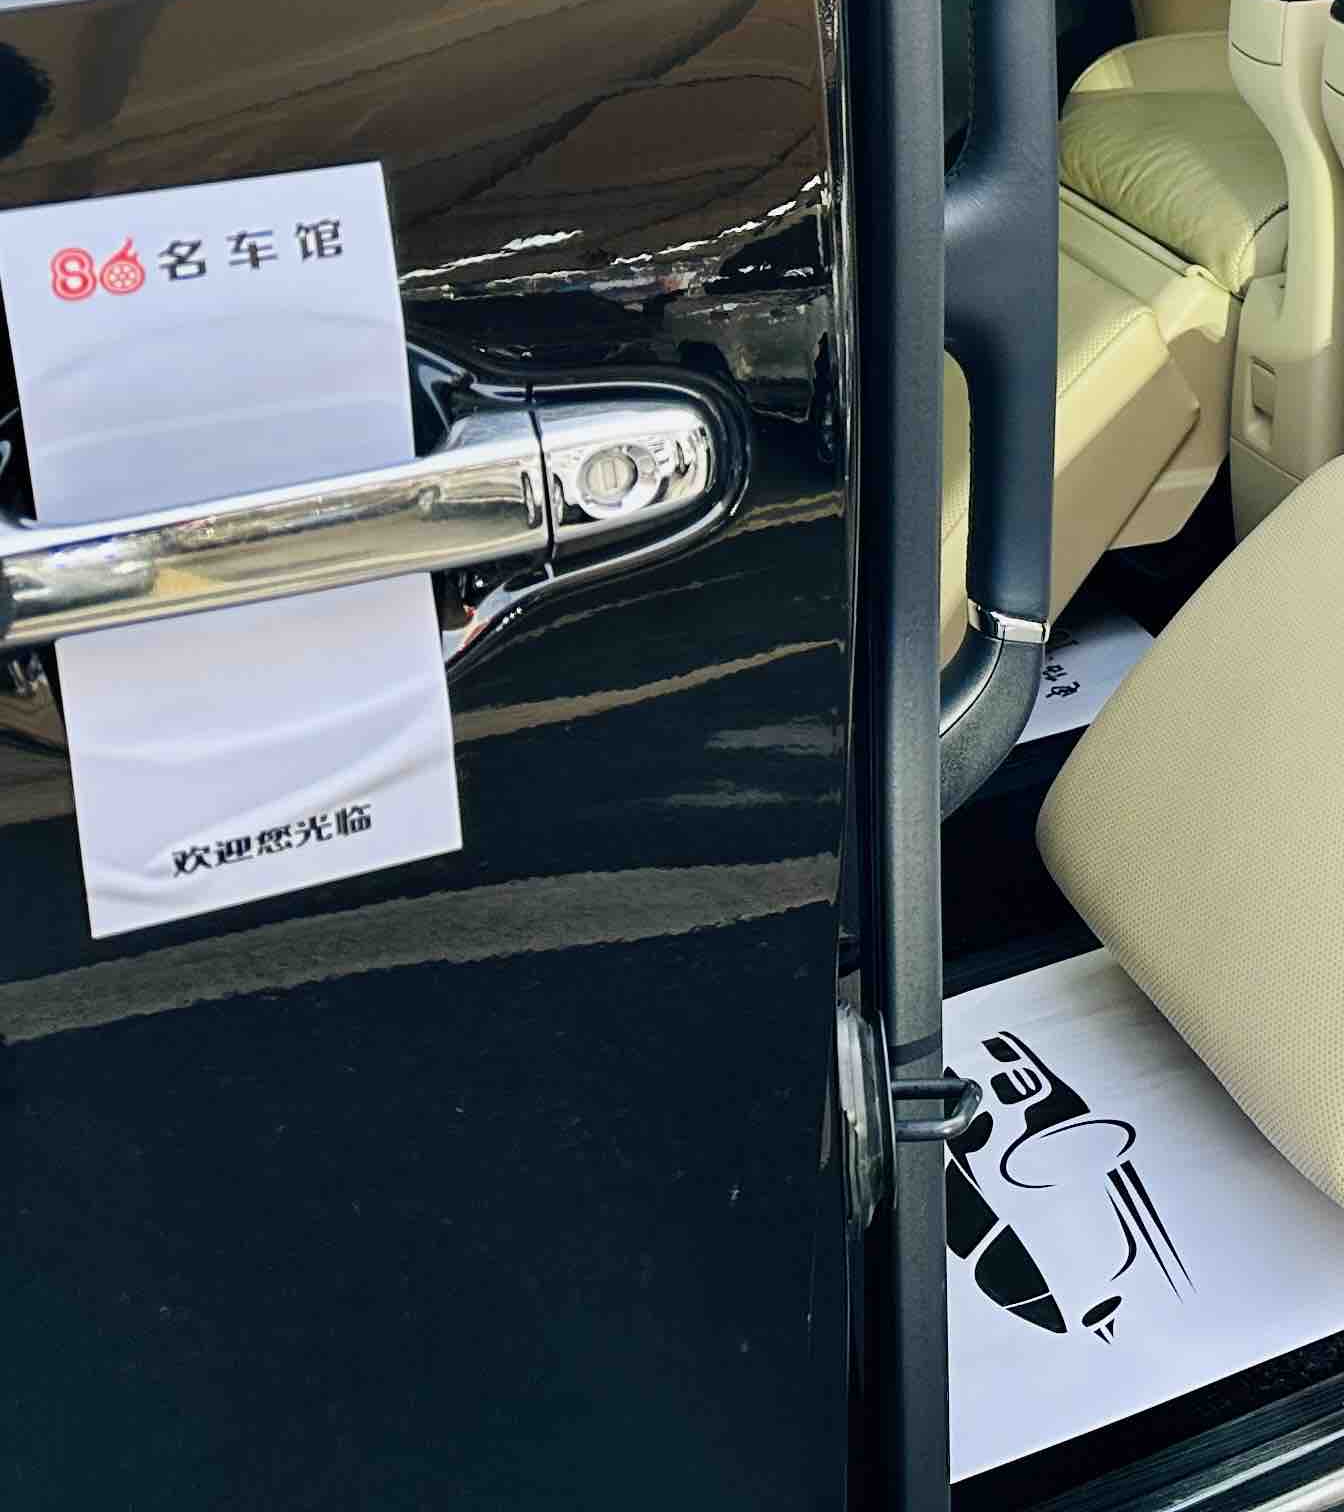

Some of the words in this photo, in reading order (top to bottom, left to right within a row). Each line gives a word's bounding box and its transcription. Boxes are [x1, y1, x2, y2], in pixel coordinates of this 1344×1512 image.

[171, 803, 372, 878] 欢迎您光临
